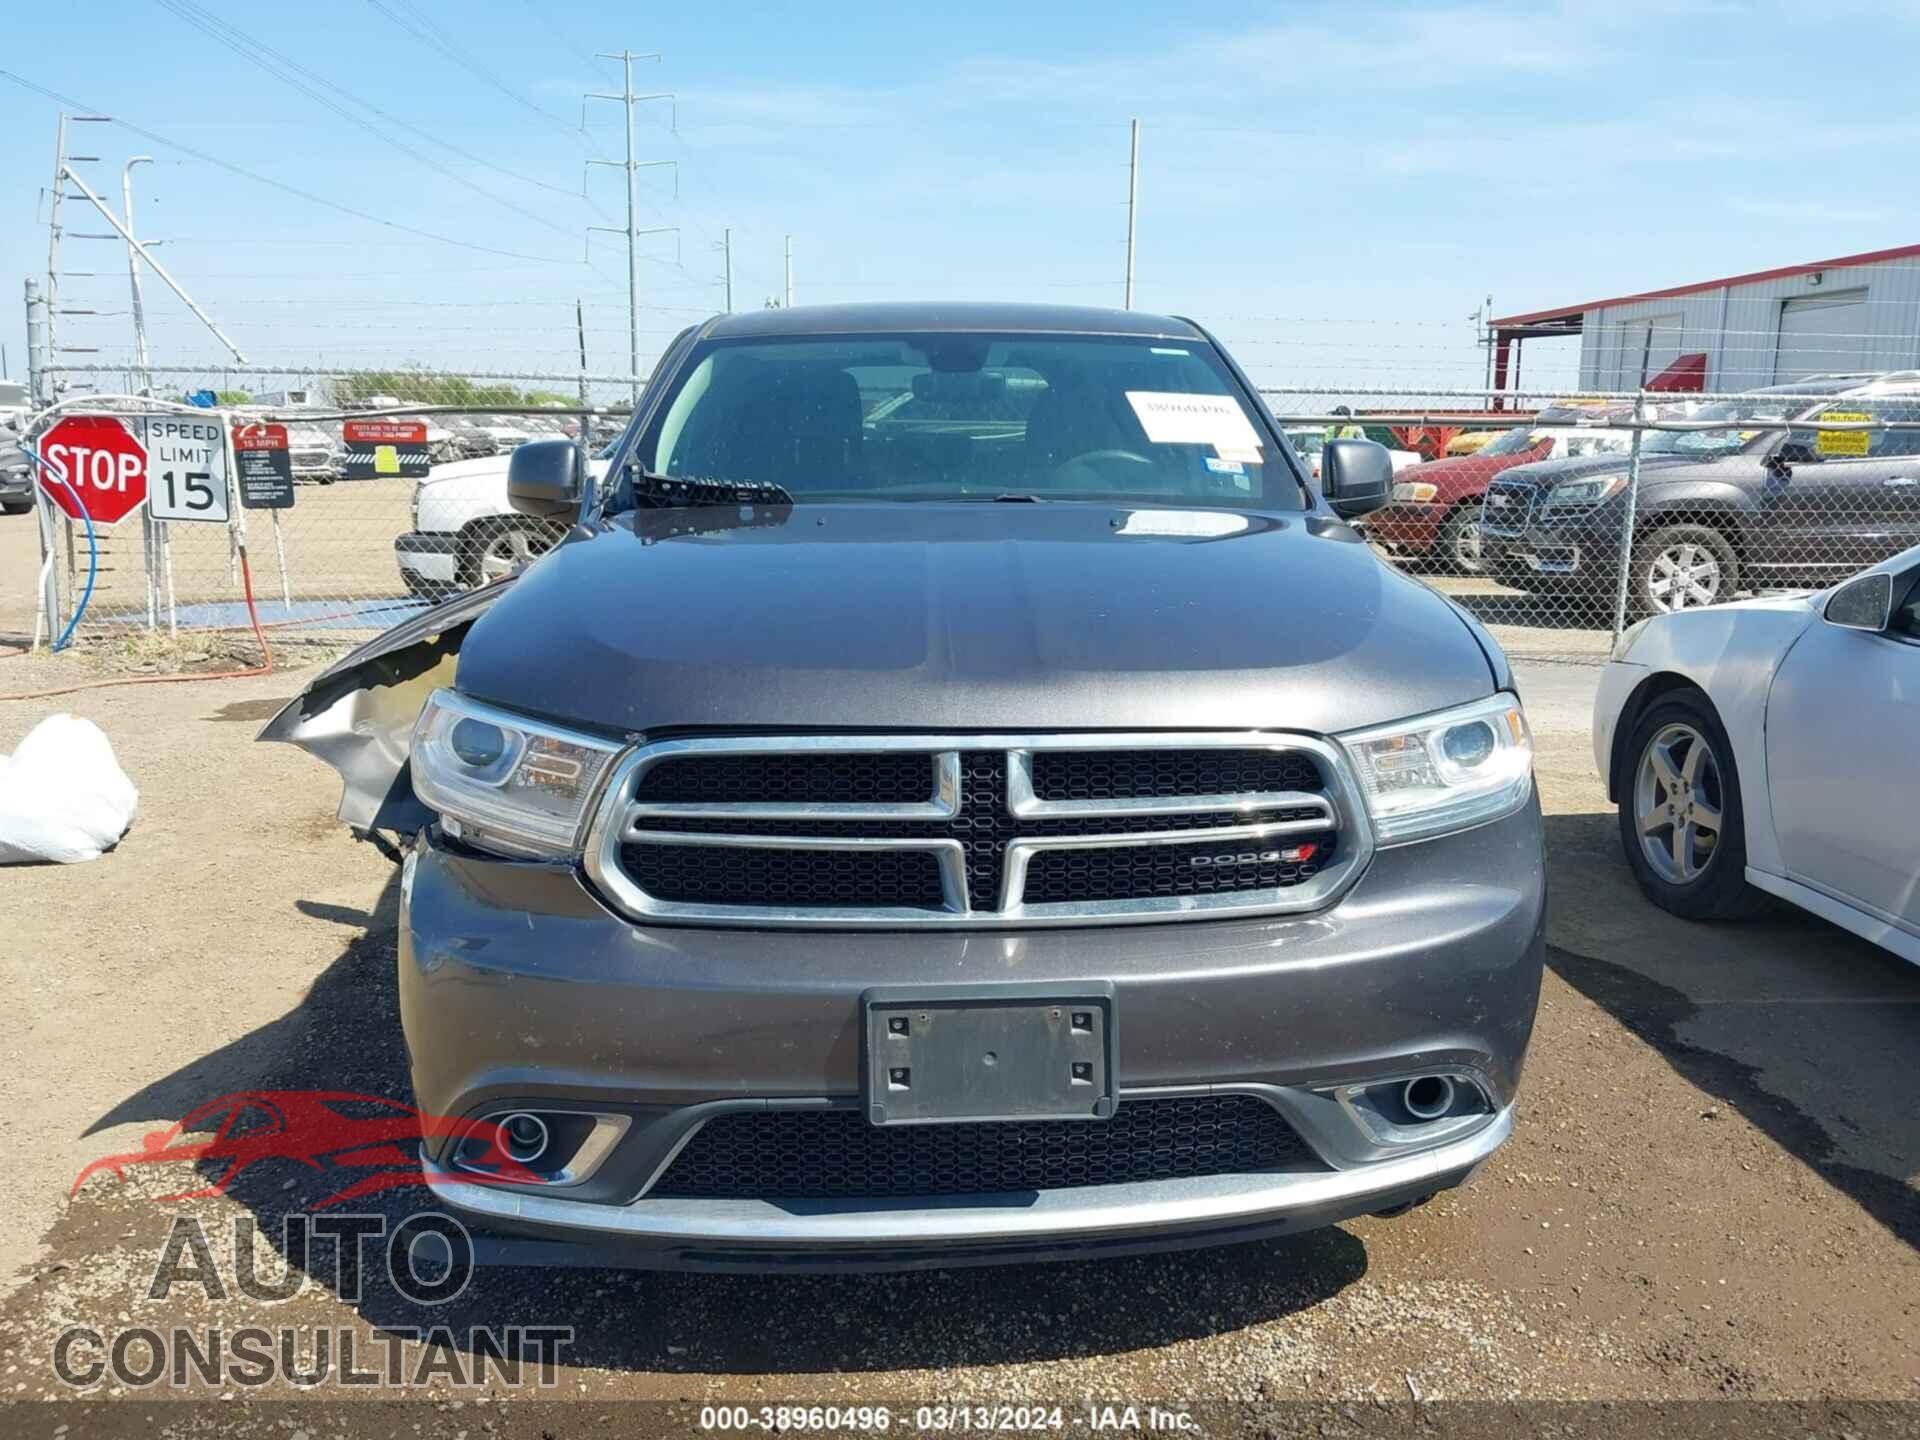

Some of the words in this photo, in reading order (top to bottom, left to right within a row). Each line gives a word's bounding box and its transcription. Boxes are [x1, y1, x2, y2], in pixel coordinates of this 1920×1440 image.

[151, 422, 219, 442] SPEED
[160, 447, 213, 464] LIMIT
[46, 443, 142, 492] STOP
[162, 471, 214, 511] 15
[1190, 850, 1303, 866] DODGE
